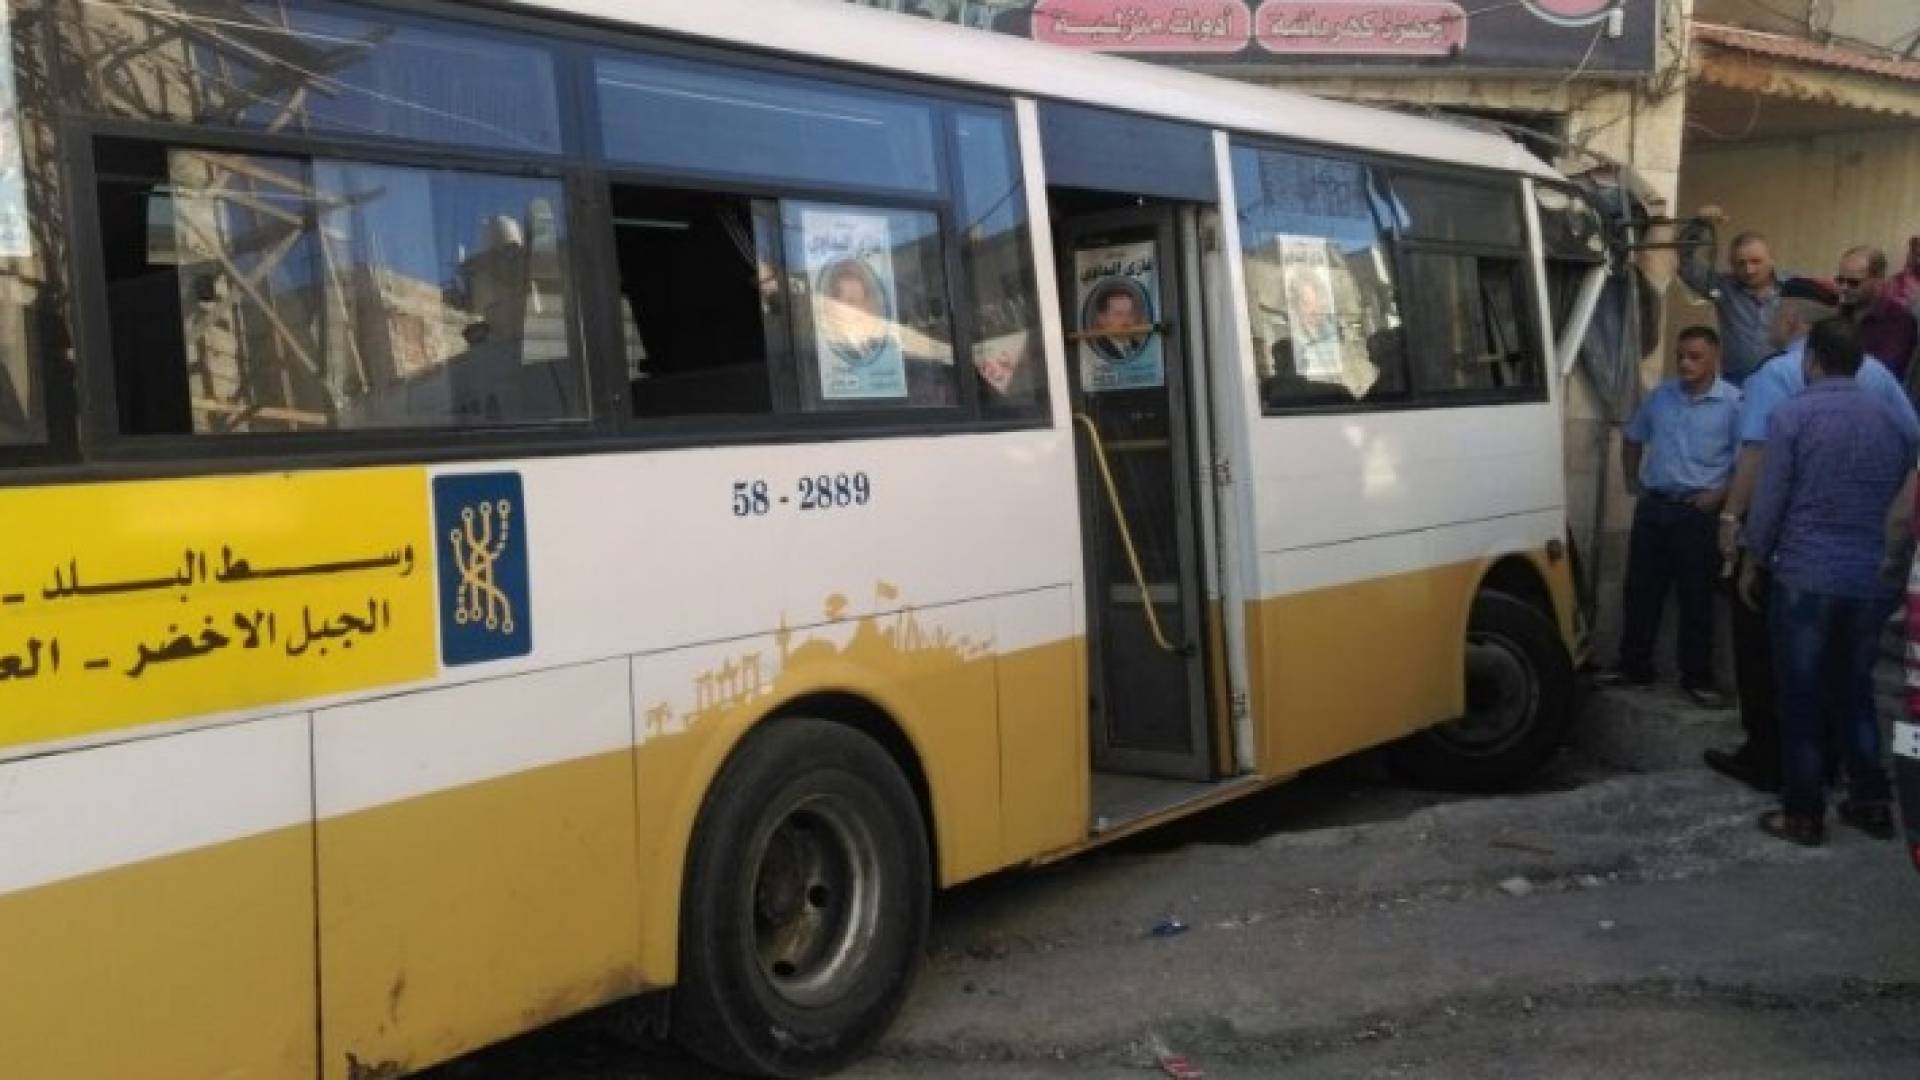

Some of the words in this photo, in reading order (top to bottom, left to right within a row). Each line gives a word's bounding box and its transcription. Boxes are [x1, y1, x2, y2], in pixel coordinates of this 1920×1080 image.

[1055, 7, 1163, 42] منزلية
[1169, 6, 1233, 41] أدوات
[734, 480, 769, 516] 58
[779, 495, 790, 504] -
[798, 472, 870, 510] 2889
[43, 548, 207, 602] البلد
[216, 545, 413, 583] وسط
[125, 610, 275, 678] الاخضر
[285, 597, 390, 657] الجبل
